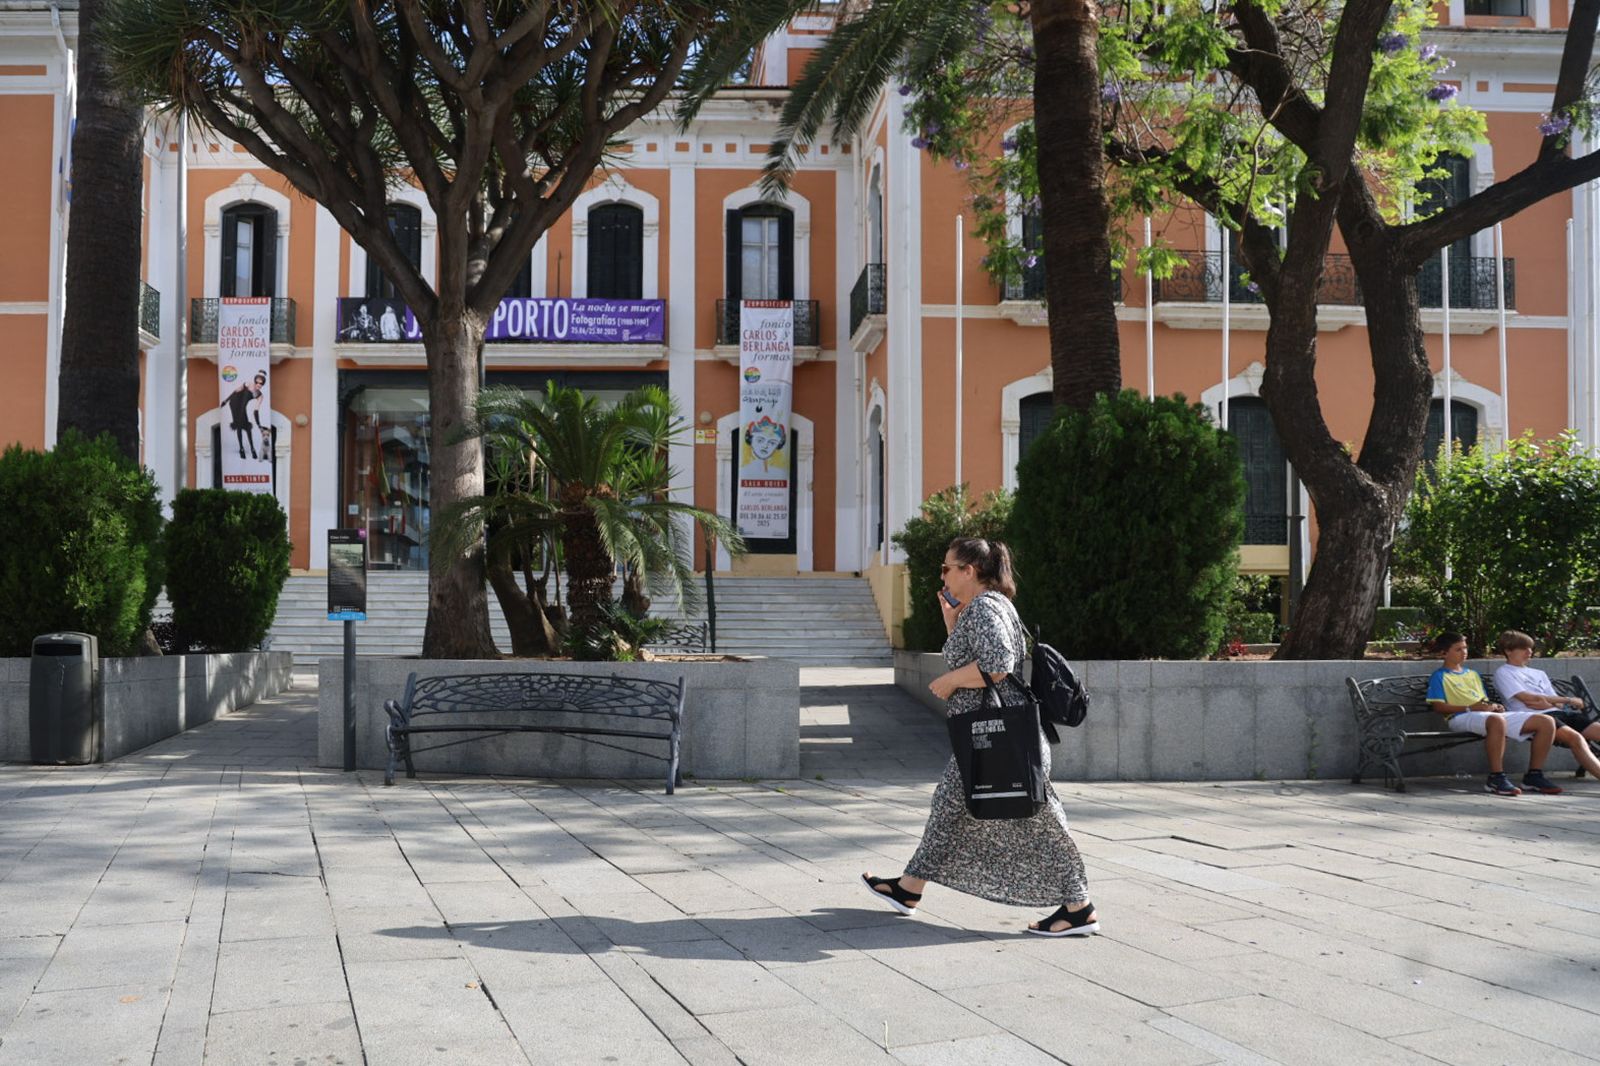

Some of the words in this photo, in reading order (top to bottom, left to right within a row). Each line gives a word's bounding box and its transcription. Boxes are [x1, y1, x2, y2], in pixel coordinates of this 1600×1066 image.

[572, 302, 585, 311] La
[587, 303, 616, 312] noche
[238, 315, 268, 326] fondo
[493, 300, 568, 338] PORTO
[571, 313, 616, 327] Fotografías
[760, 320, 791, 330] fondo
[221, 326, 254, 337] CARLOS
[743, 330, 777, 341] CARLOS
[220, 337, 266, 348] BERLANGA
[743, 341, 790, 352] BERLANGA
[230, 349, 266, 359] formas
[752, 352, 791, 362] formas
[761, 504, 787, 512] BERLANGA
